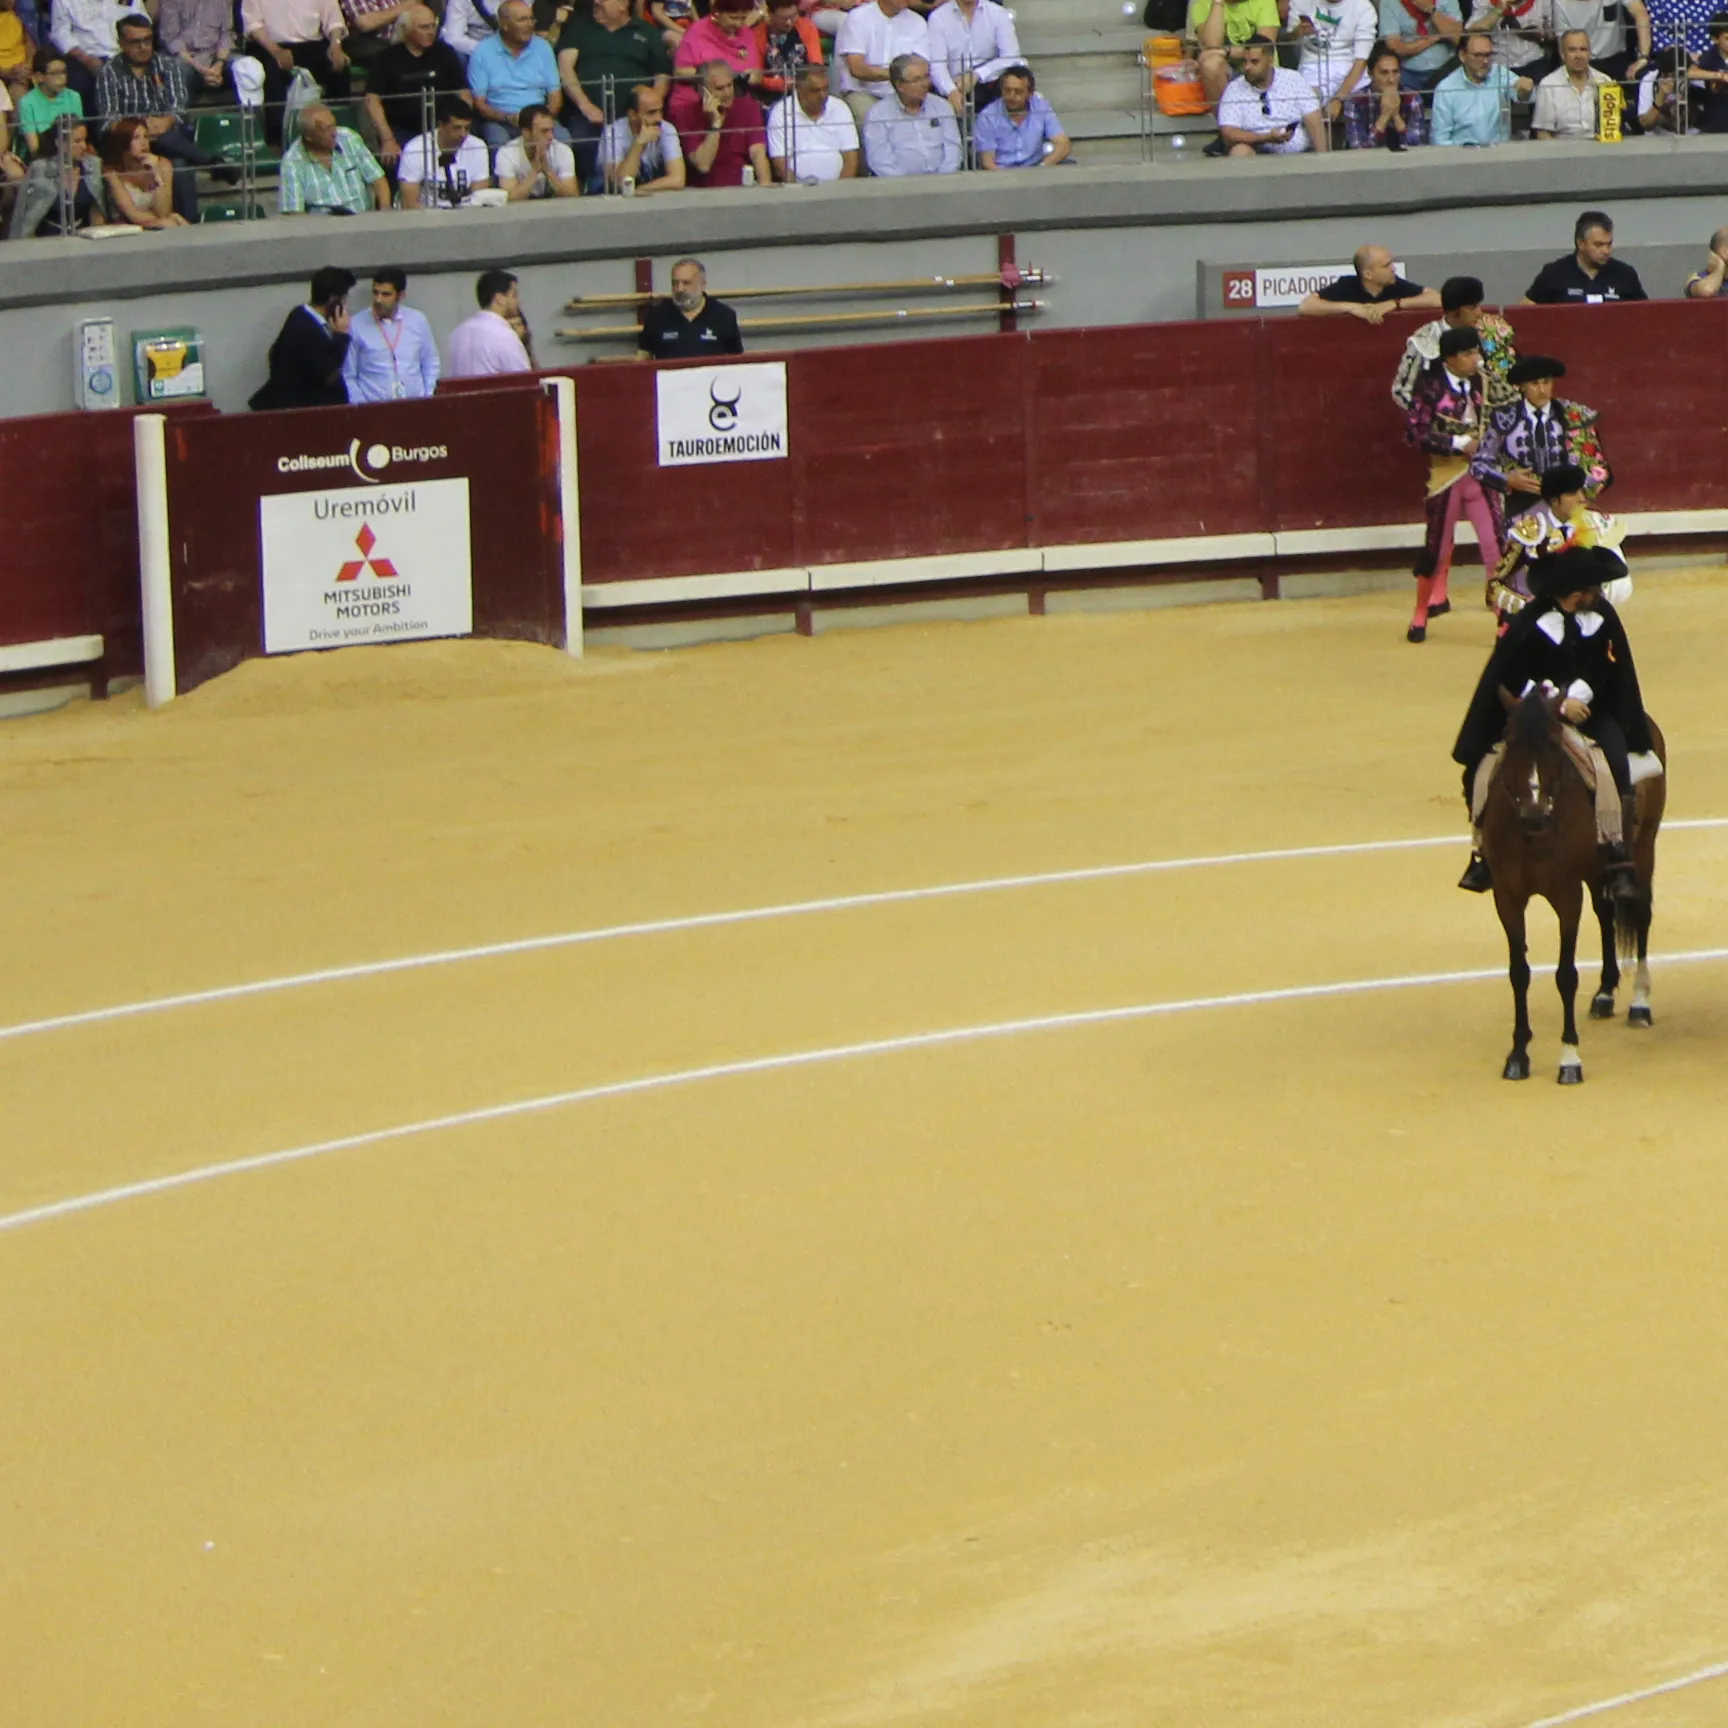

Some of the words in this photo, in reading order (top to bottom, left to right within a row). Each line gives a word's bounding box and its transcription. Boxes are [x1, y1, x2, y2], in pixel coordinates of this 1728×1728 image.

[1229, 279, 1254, 300] 28
[669, 431, 781, 458] TAUROEMOCIÓN
[278, 453, 350, 472] Coliseum
[393, 443, 449, 462] Burgos
[314, 490, 417, 520] Uremóvil
[324, 583, 412, 605] MITSUBISHI
[337, 600, 401, 620] MOTORS
[310, 629, 340, 642] Drive
[344, 625, 370, 640] your
[374, 619, 429, 636] Ambition
